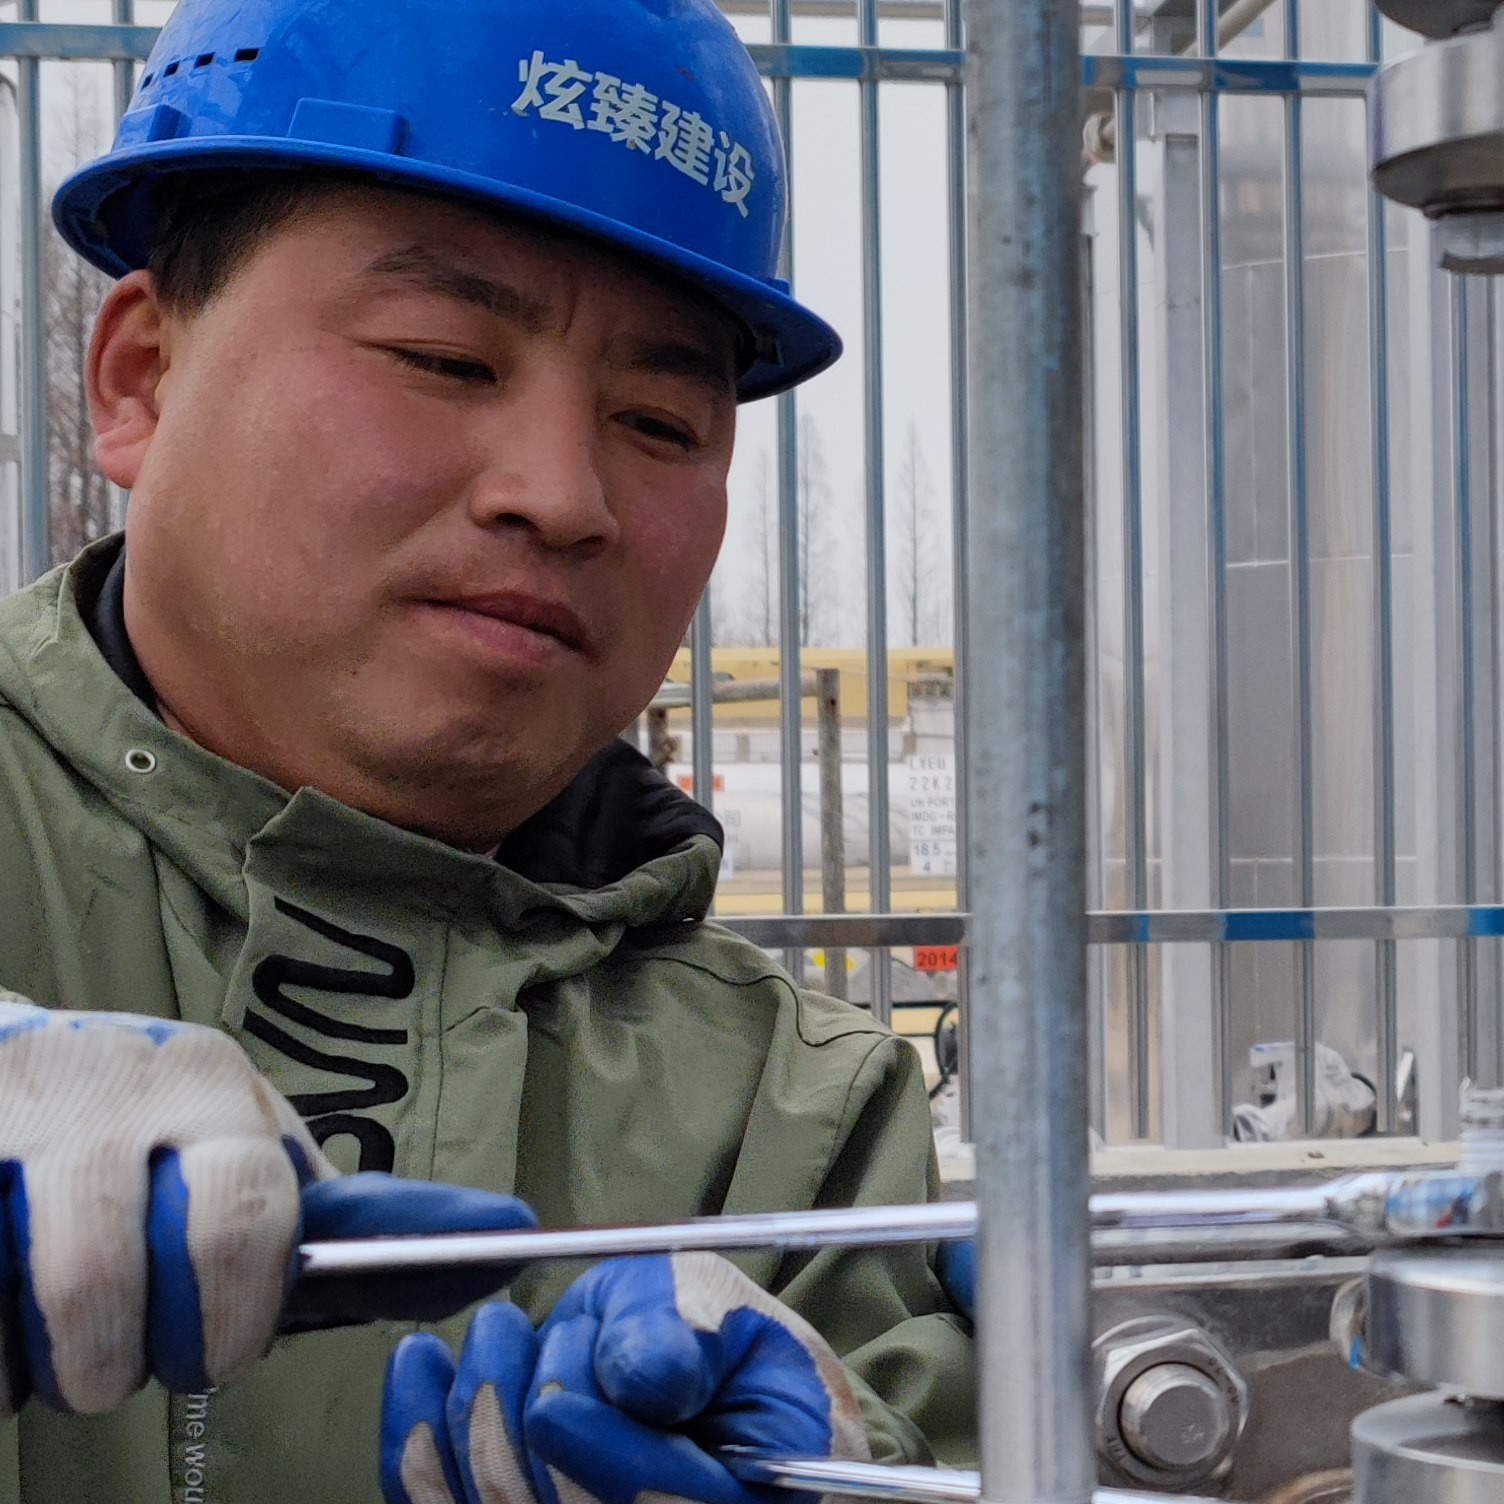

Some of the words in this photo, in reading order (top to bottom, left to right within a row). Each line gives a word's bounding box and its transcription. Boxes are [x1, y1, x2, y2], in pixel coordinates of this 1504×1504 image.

[516, 49, 756, 219] 炫臻建设
[916, 951, 958, 968] 2014
